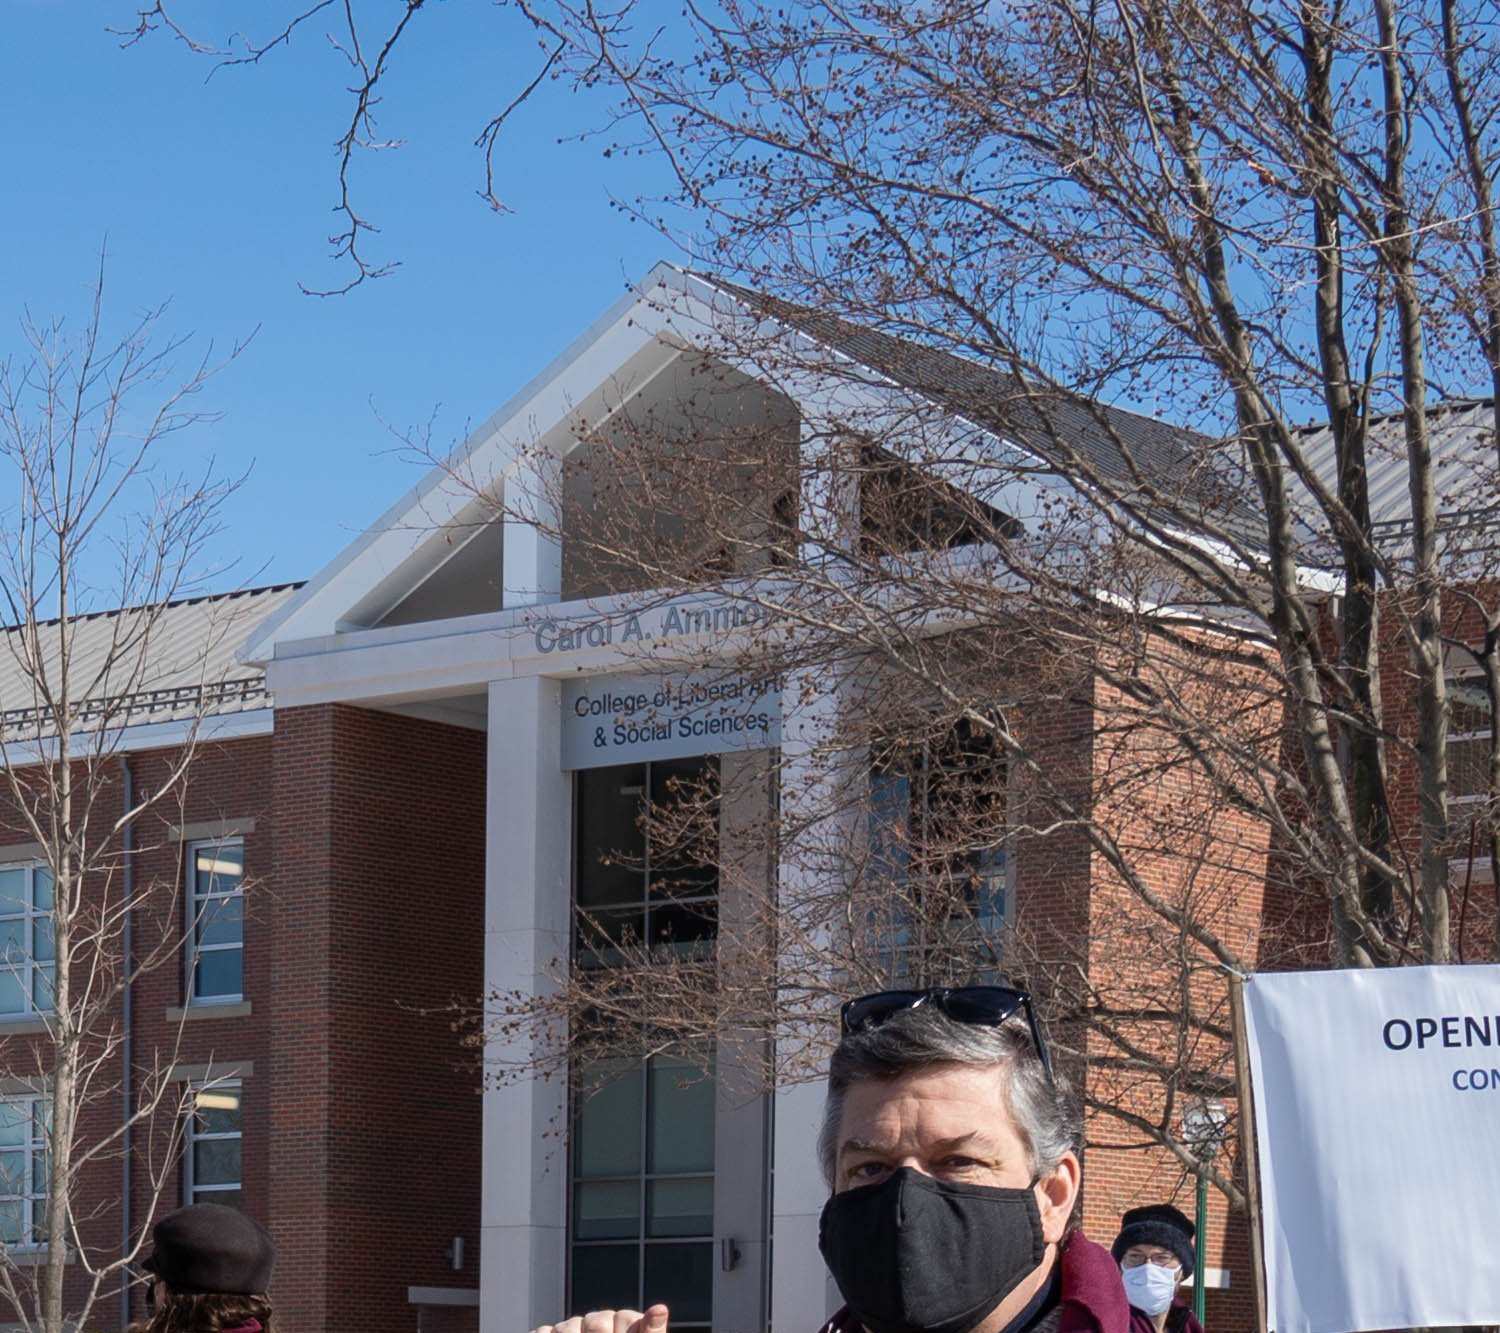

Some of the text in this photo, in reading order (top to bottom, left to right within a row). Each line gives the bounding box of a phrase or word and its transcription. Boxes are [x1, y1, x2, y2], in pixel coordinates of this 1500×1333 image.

[535, 601, 772, 653] Carol A. Ammo
[575, 676, 784, 718] College of Liberal Art
[594, 711, 769, 748] & Social Sciences
